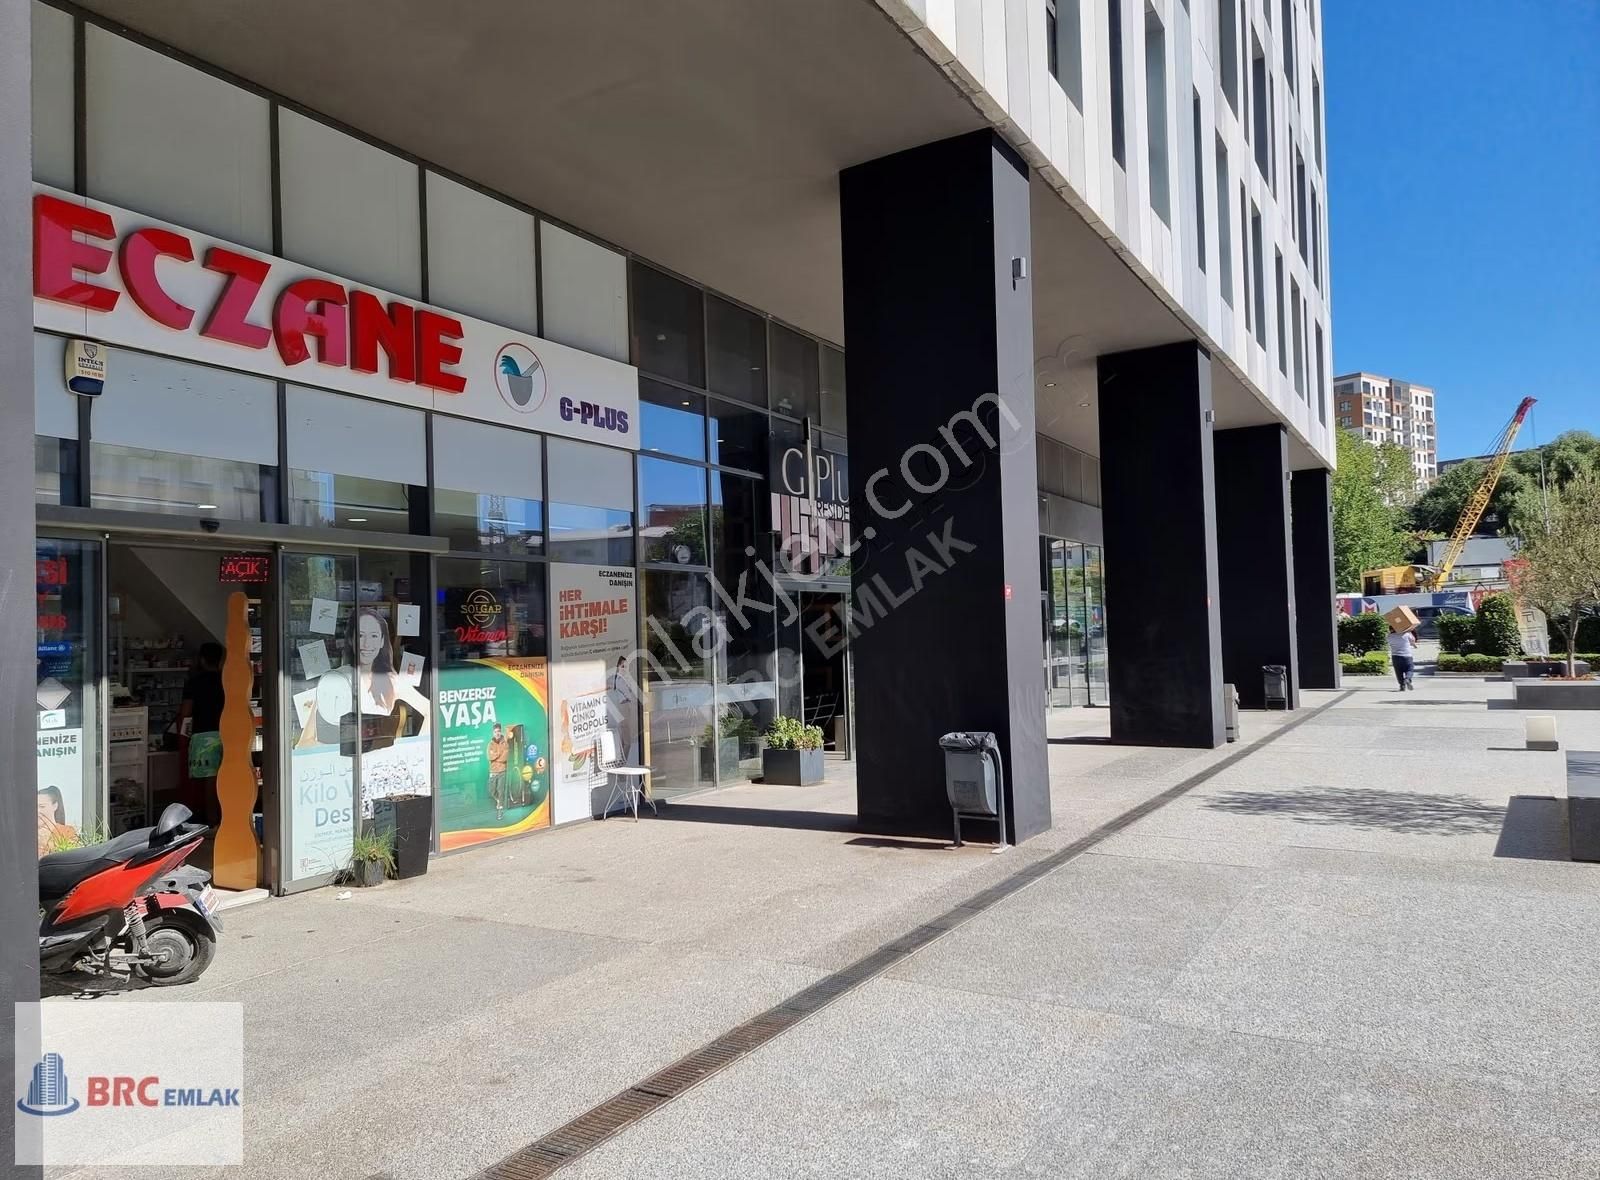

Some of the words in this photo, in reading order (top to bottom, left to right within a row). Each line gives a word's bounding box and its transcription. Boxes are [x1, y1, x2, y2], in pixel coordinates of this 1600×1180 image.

[33, 194, 467, 394] ECZANE
[560, 397, 629, 433] G-PLUS
[225, 561, 260, 577] AÇIK
[560, 589, 582, 602] HER
[461, 604, 502, 614] SOLGAR
[560, 618, 608, 639] KARŞI!
[440, 701, 497, 729] YAŞA
[299, 782, 337, 806] Kilo
[315, 807, 352, 827] Des
